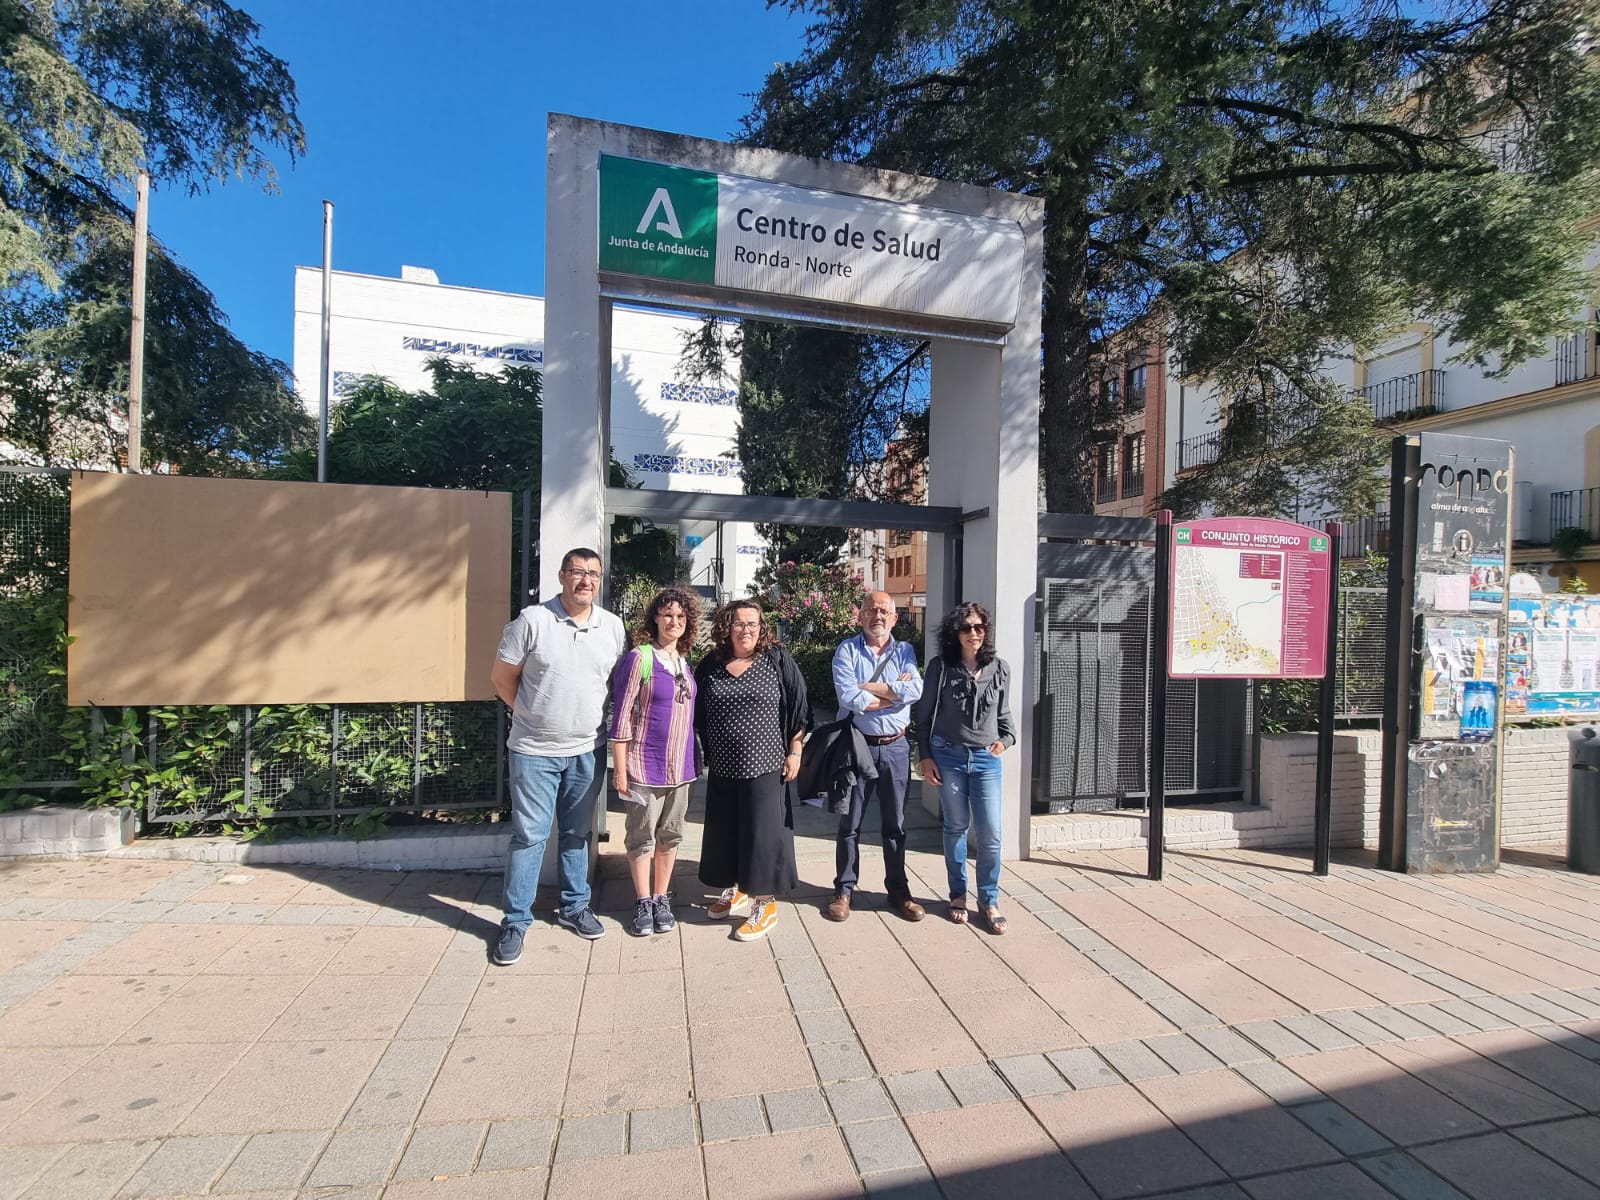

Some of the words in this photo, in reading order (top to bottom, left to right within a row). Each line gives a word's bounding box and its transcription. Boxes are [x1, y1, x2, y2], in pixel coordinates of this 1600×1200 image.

[736, 207, 827, 244] Centro
[833, 222, 865, 250] de
[871, 230, 941, 262] Salud
[608, 235, 640, 249] Junta
[641, 239, 656, 251] de
[657, 241, 709, 259] Andalucía
[734, 245, 790, 270] Ronda
[805, 256, 853, 279] Norte
[1431, 502, 1451, 512] alma
[1452, 504, 1461, 513] de
[1177, 531, 1190, 540] CH
[1201, 530, 1250, 542] CONJUNTO
[1253, 533, 1301, 546] HISTÓRICO
